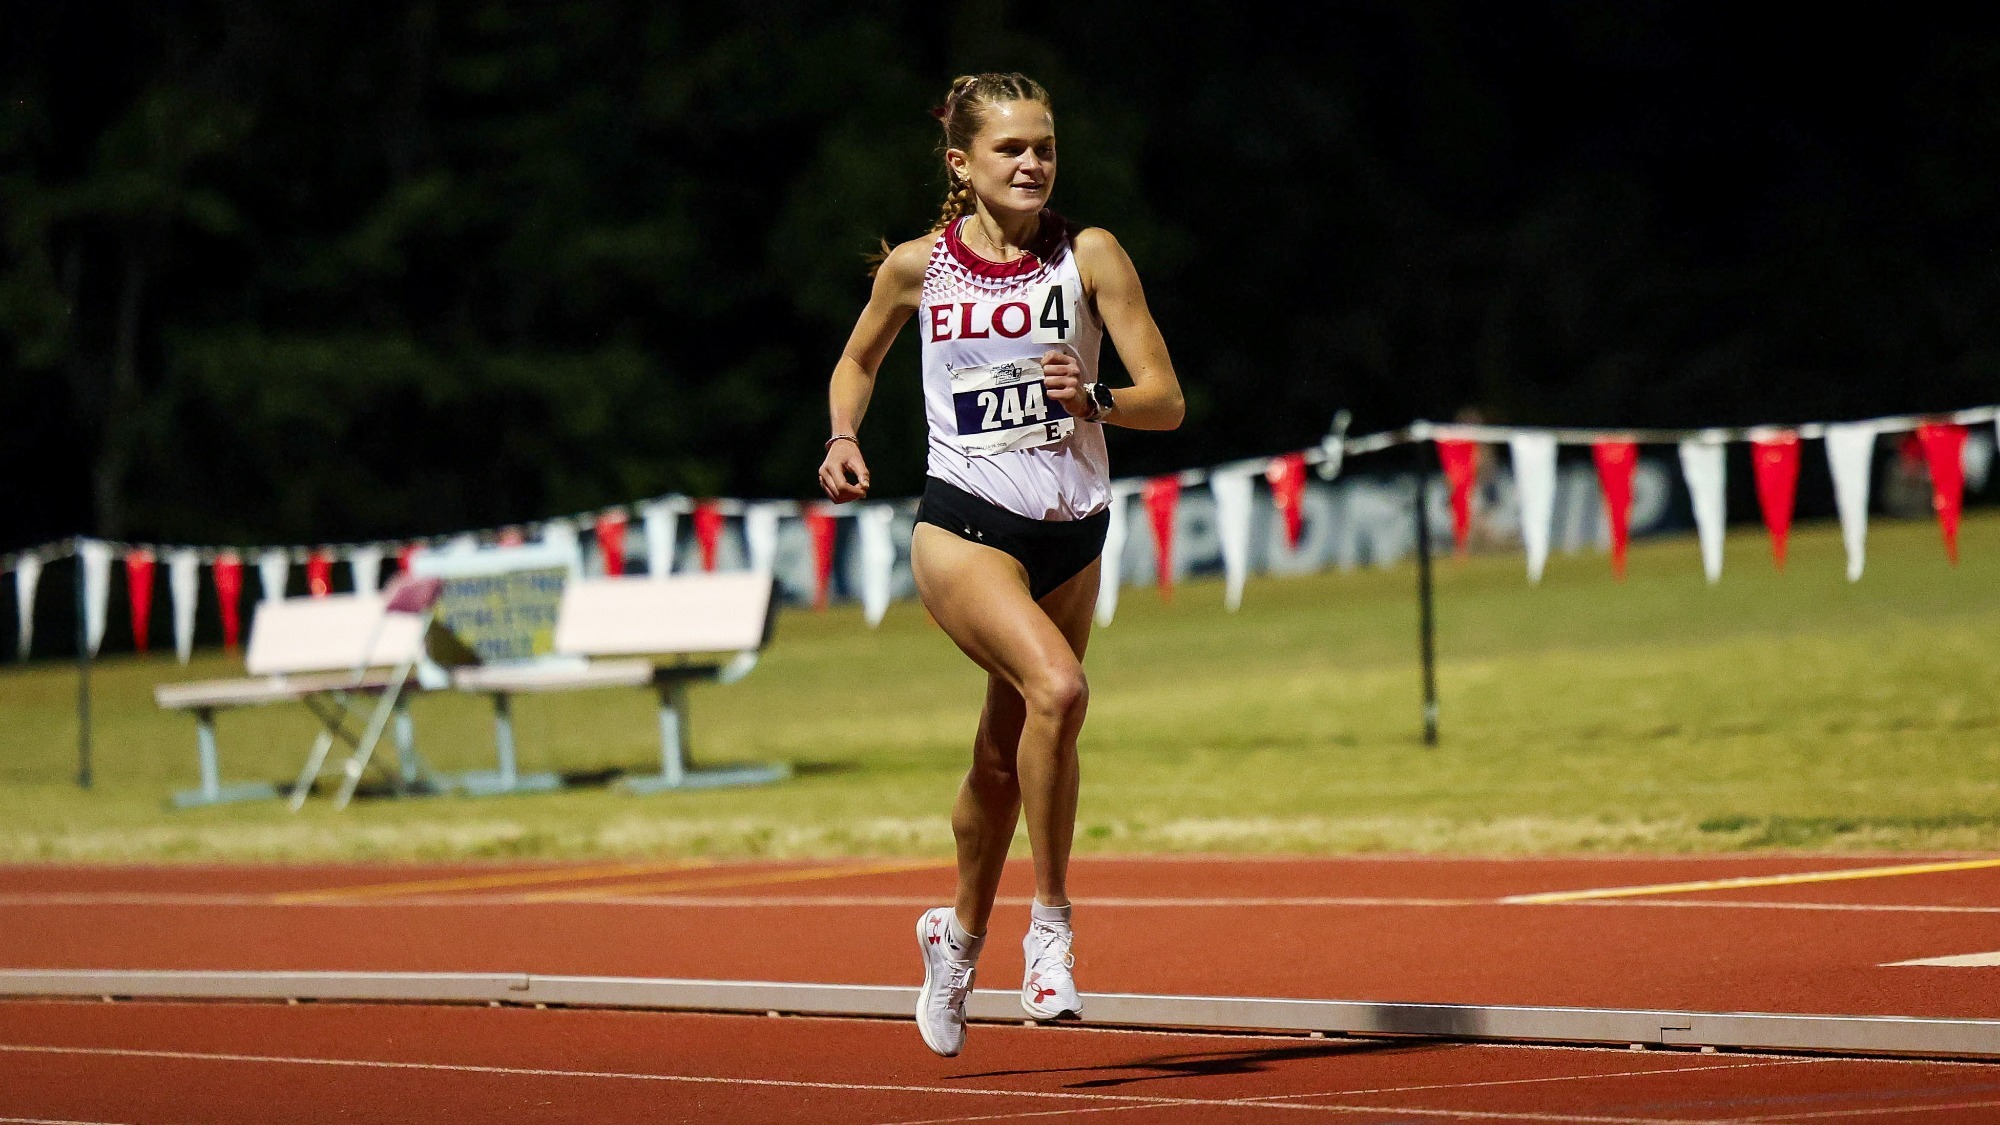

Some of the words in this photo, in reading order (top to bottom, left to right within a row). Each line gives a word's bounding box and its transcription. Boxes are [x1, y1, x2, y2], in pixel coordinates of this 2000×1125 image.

[929, 301, 1032, 344] ELO
[1039, 284, 1070, 340] 4
[977, 382, 1048, 431] 244
[1043, 421, 1062, 442] E
